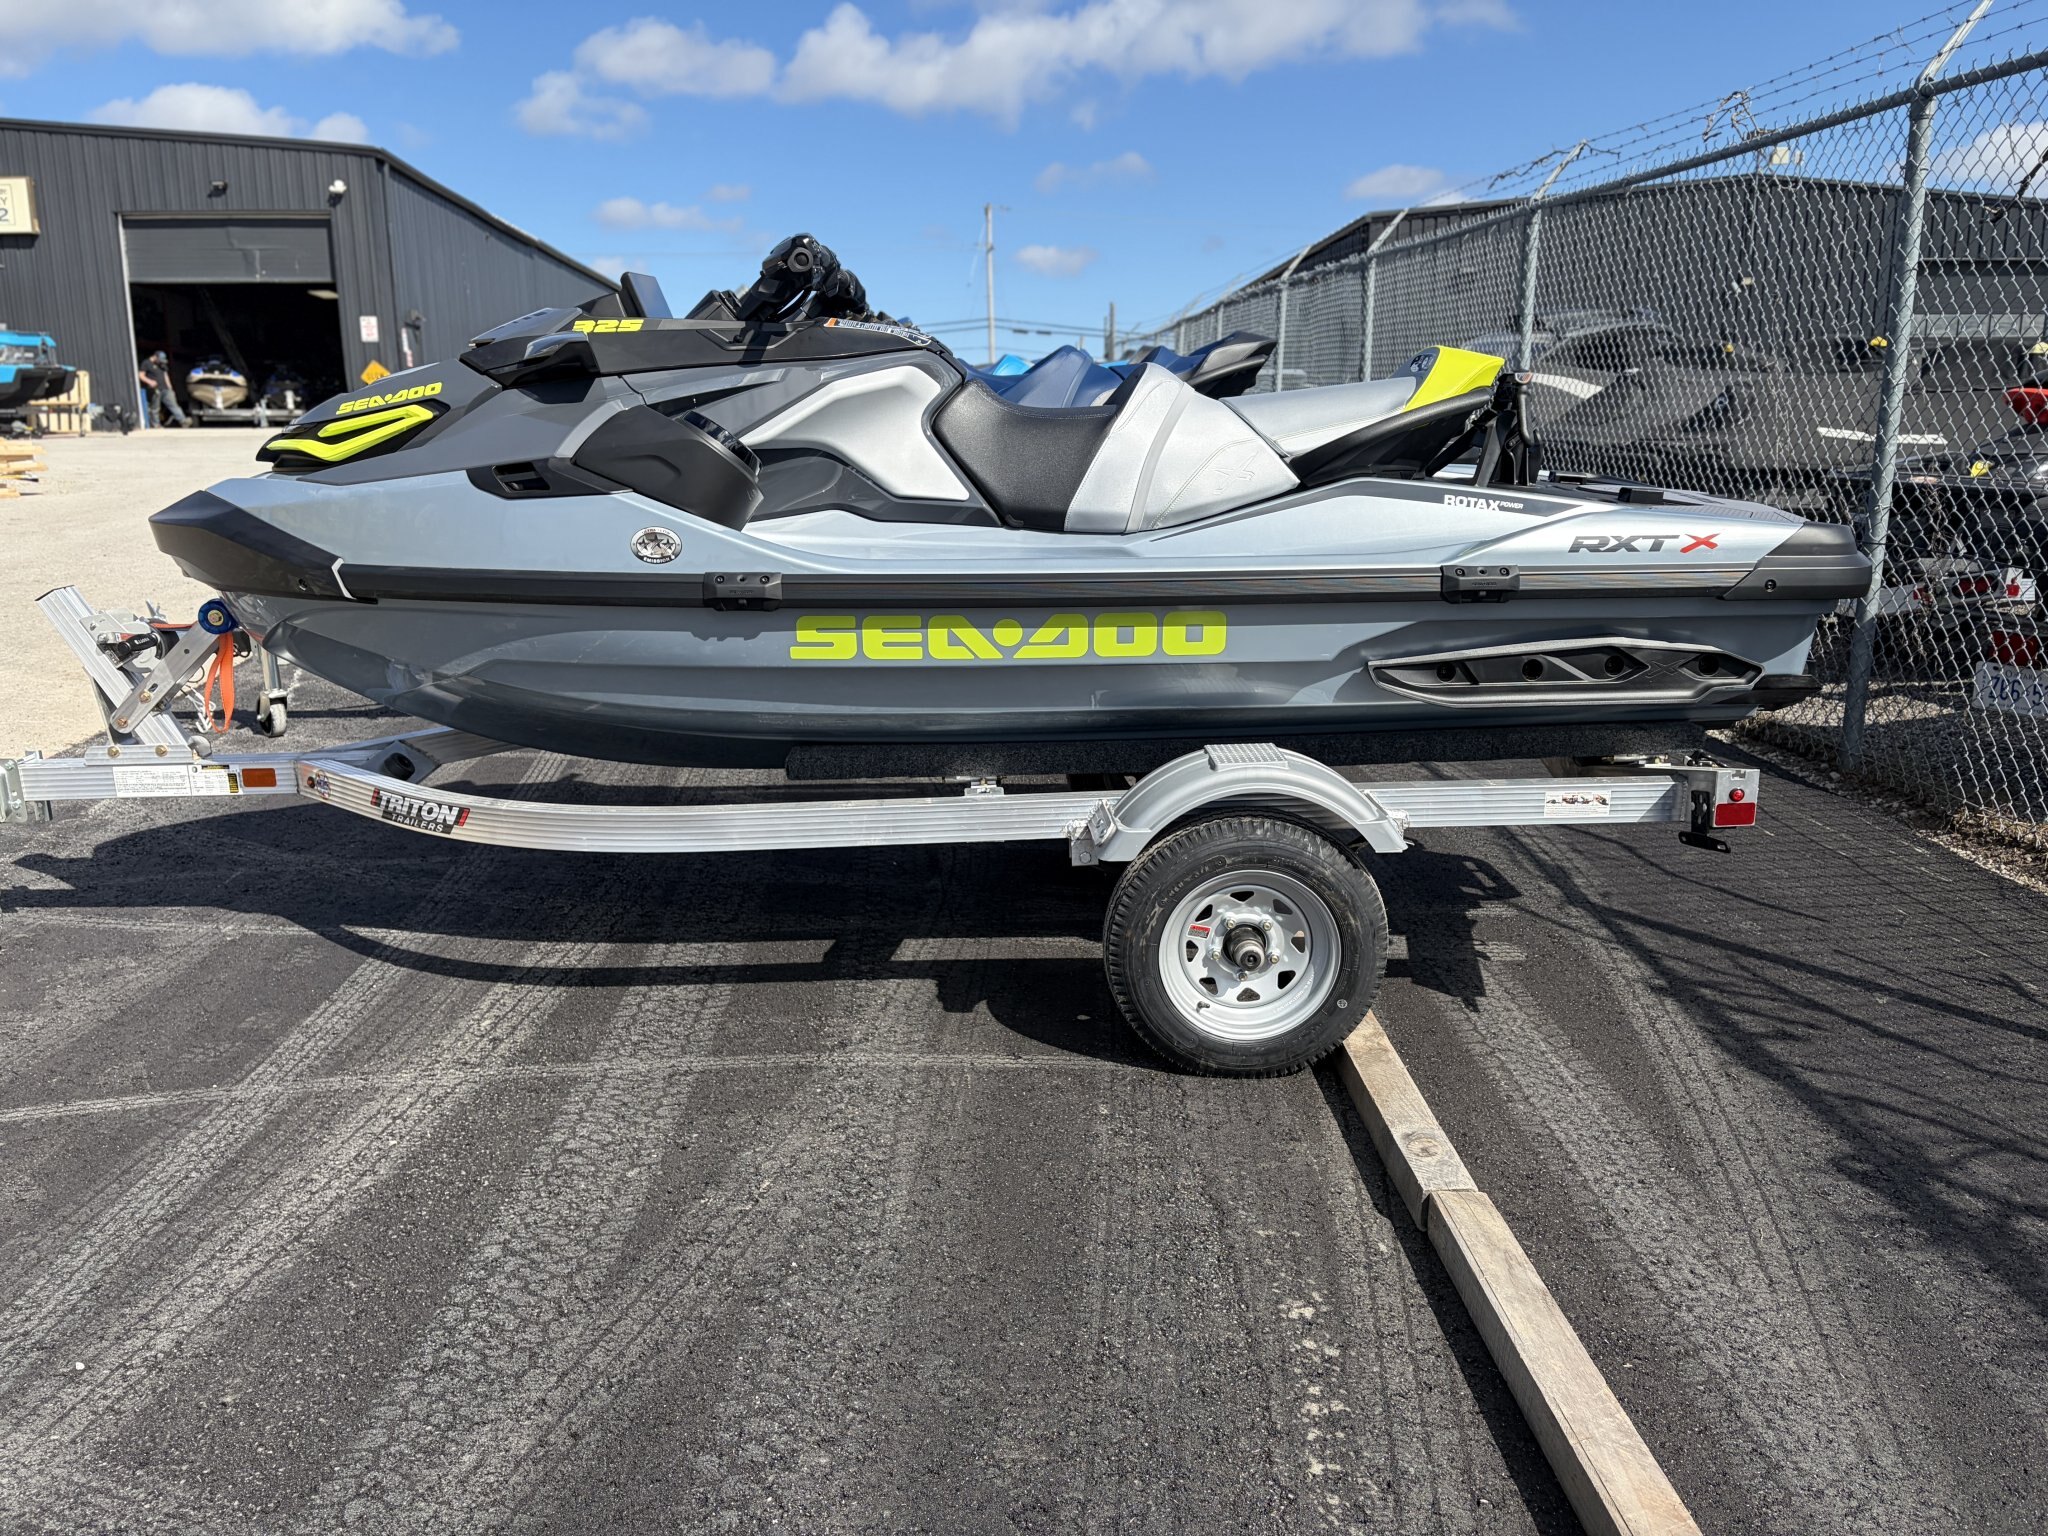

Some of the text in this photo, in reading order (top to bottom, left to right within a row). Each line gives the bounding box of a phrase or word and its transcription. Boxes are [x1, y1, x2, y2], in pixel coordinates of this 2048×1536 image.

[572, 319, 644, 333] 325
[1444, 494, 1524, 512] ROTAX POWER
[1568, 535, 1680, 553] RXT
[380, 790, 460, 825] TRITON
[391, 813, 444, 833] TRAILERS
